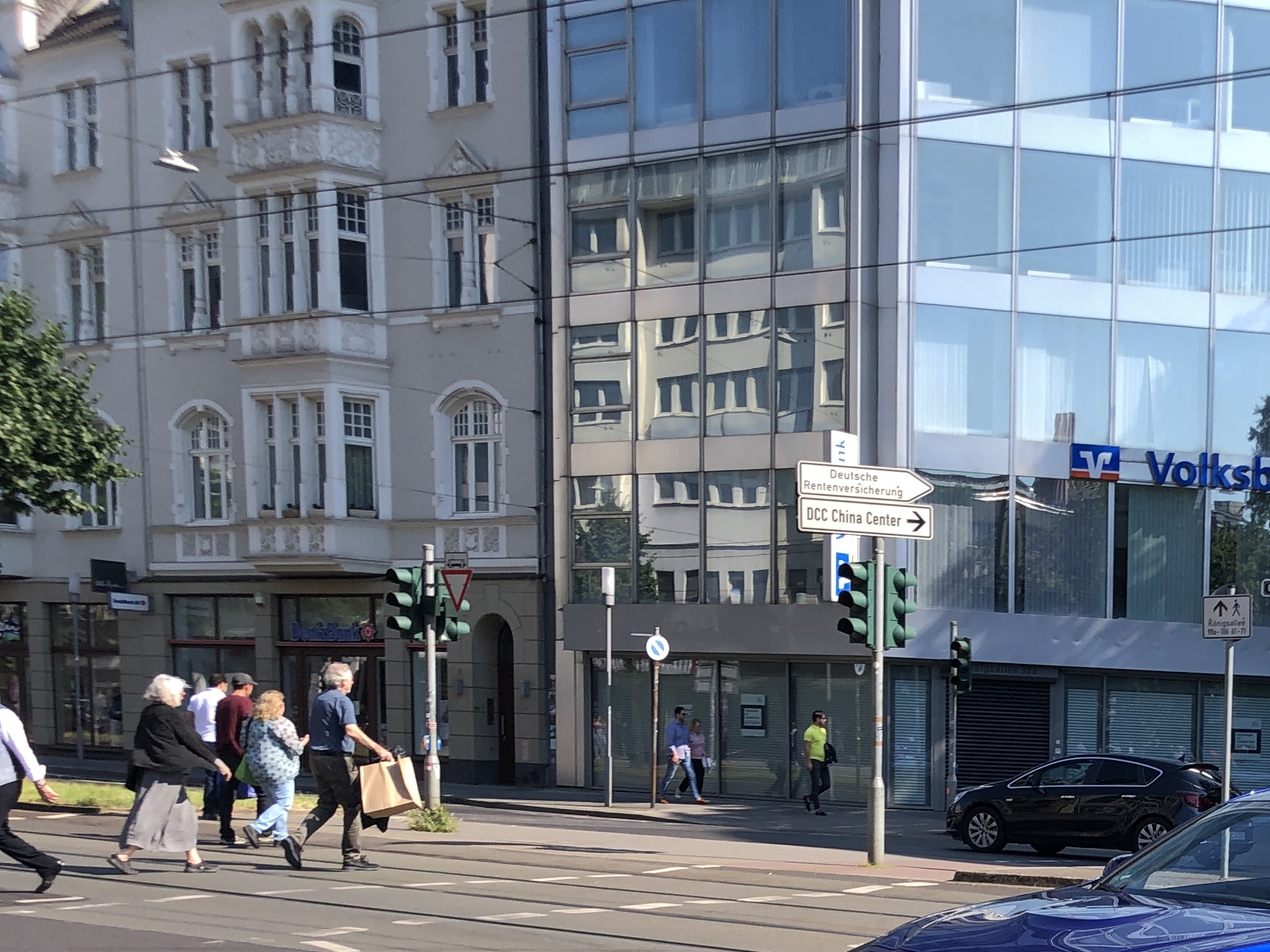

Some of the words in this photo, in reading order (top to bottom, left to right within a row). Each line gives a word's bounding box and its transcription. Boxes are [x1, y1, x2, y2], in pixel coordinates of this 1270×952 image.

[829, 469, 879, 482] Deutsche
[803, 480, 904, 499] Rentenversicherung
[806, 507, 829, 522] DCC
[831, 509, 863, 524] China
[866, 511, 902, 527] Center
